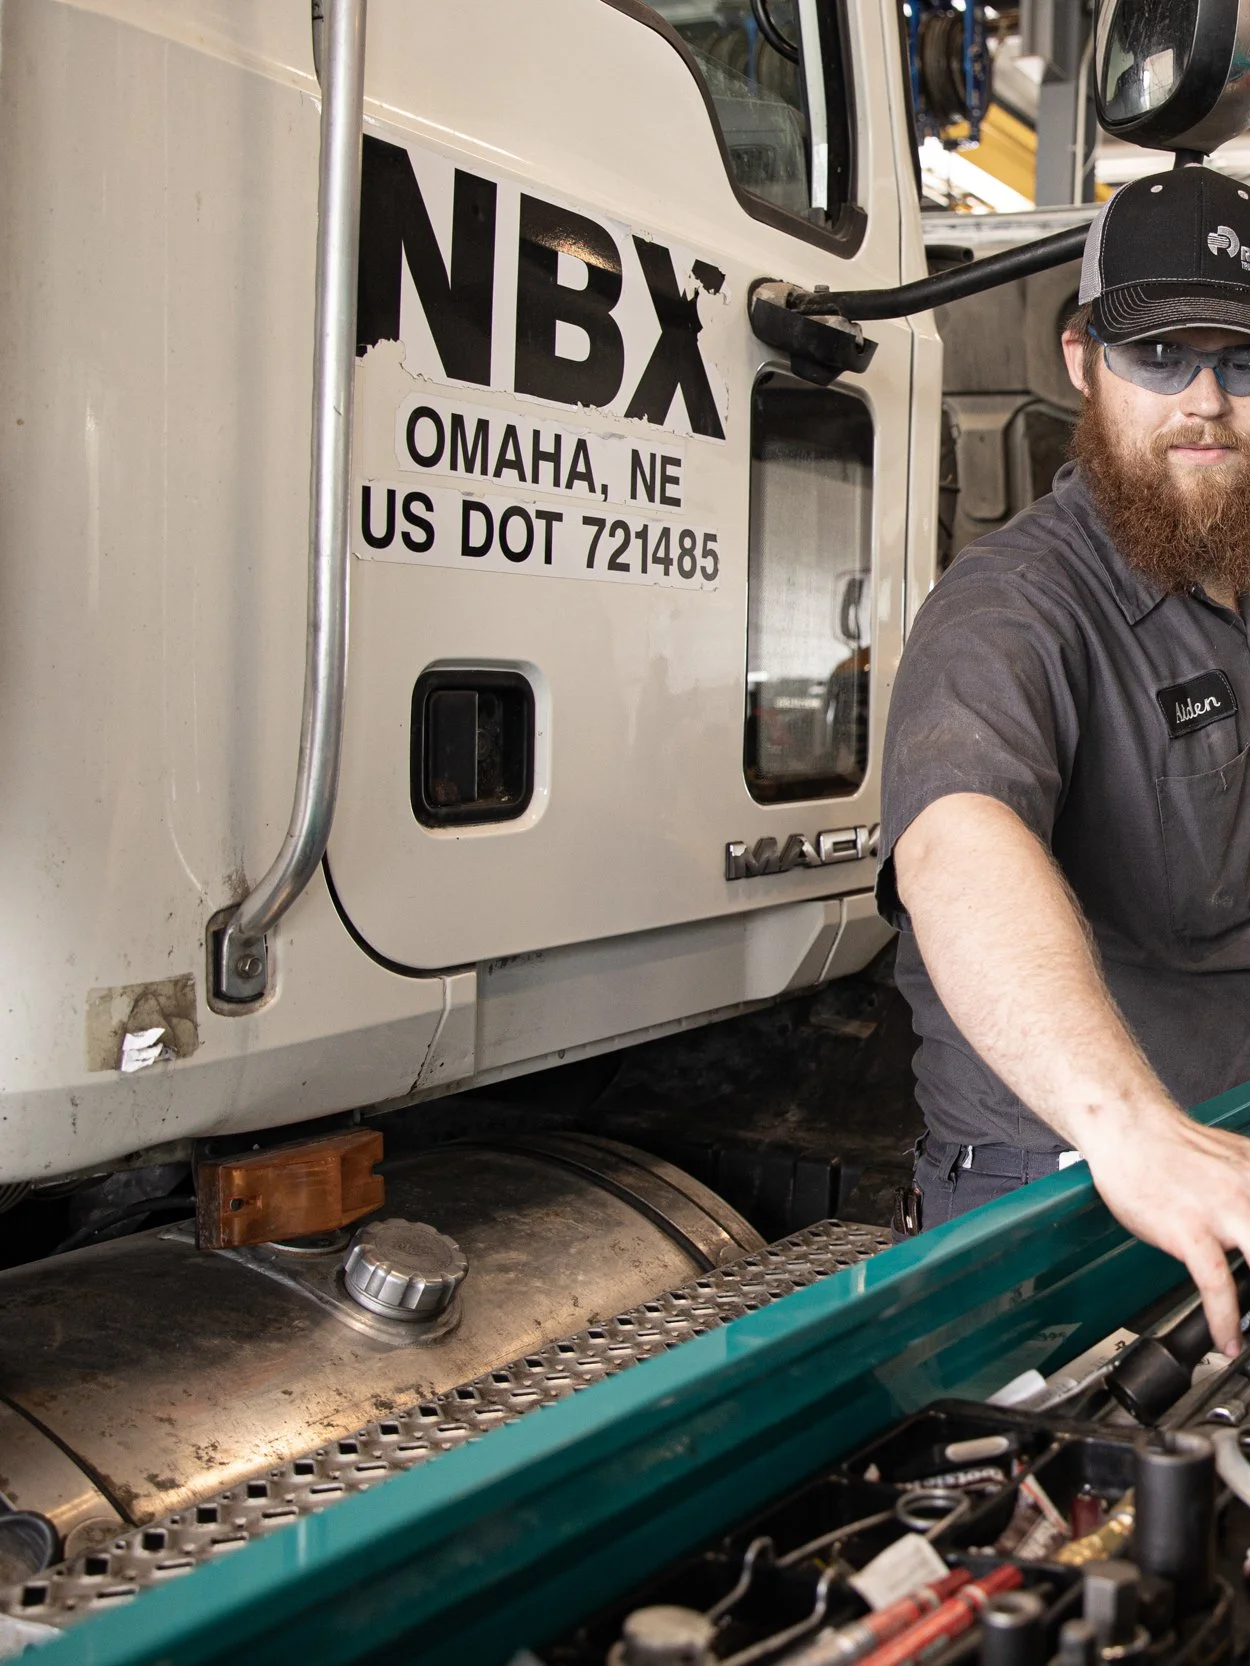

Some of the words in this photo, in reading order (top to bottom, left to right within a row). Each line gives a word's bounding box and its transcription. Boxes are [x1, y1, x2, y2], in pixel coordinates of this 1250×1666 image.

[356, 133, 726, 440] NBX
[406, 406, 609, 502] OMAHA,
[630, 448, 682, 508] NE
[361, 485, 434, 553] US
[461, 499, 563, 565] DOT
[582, 515, 719, 582] 721485
